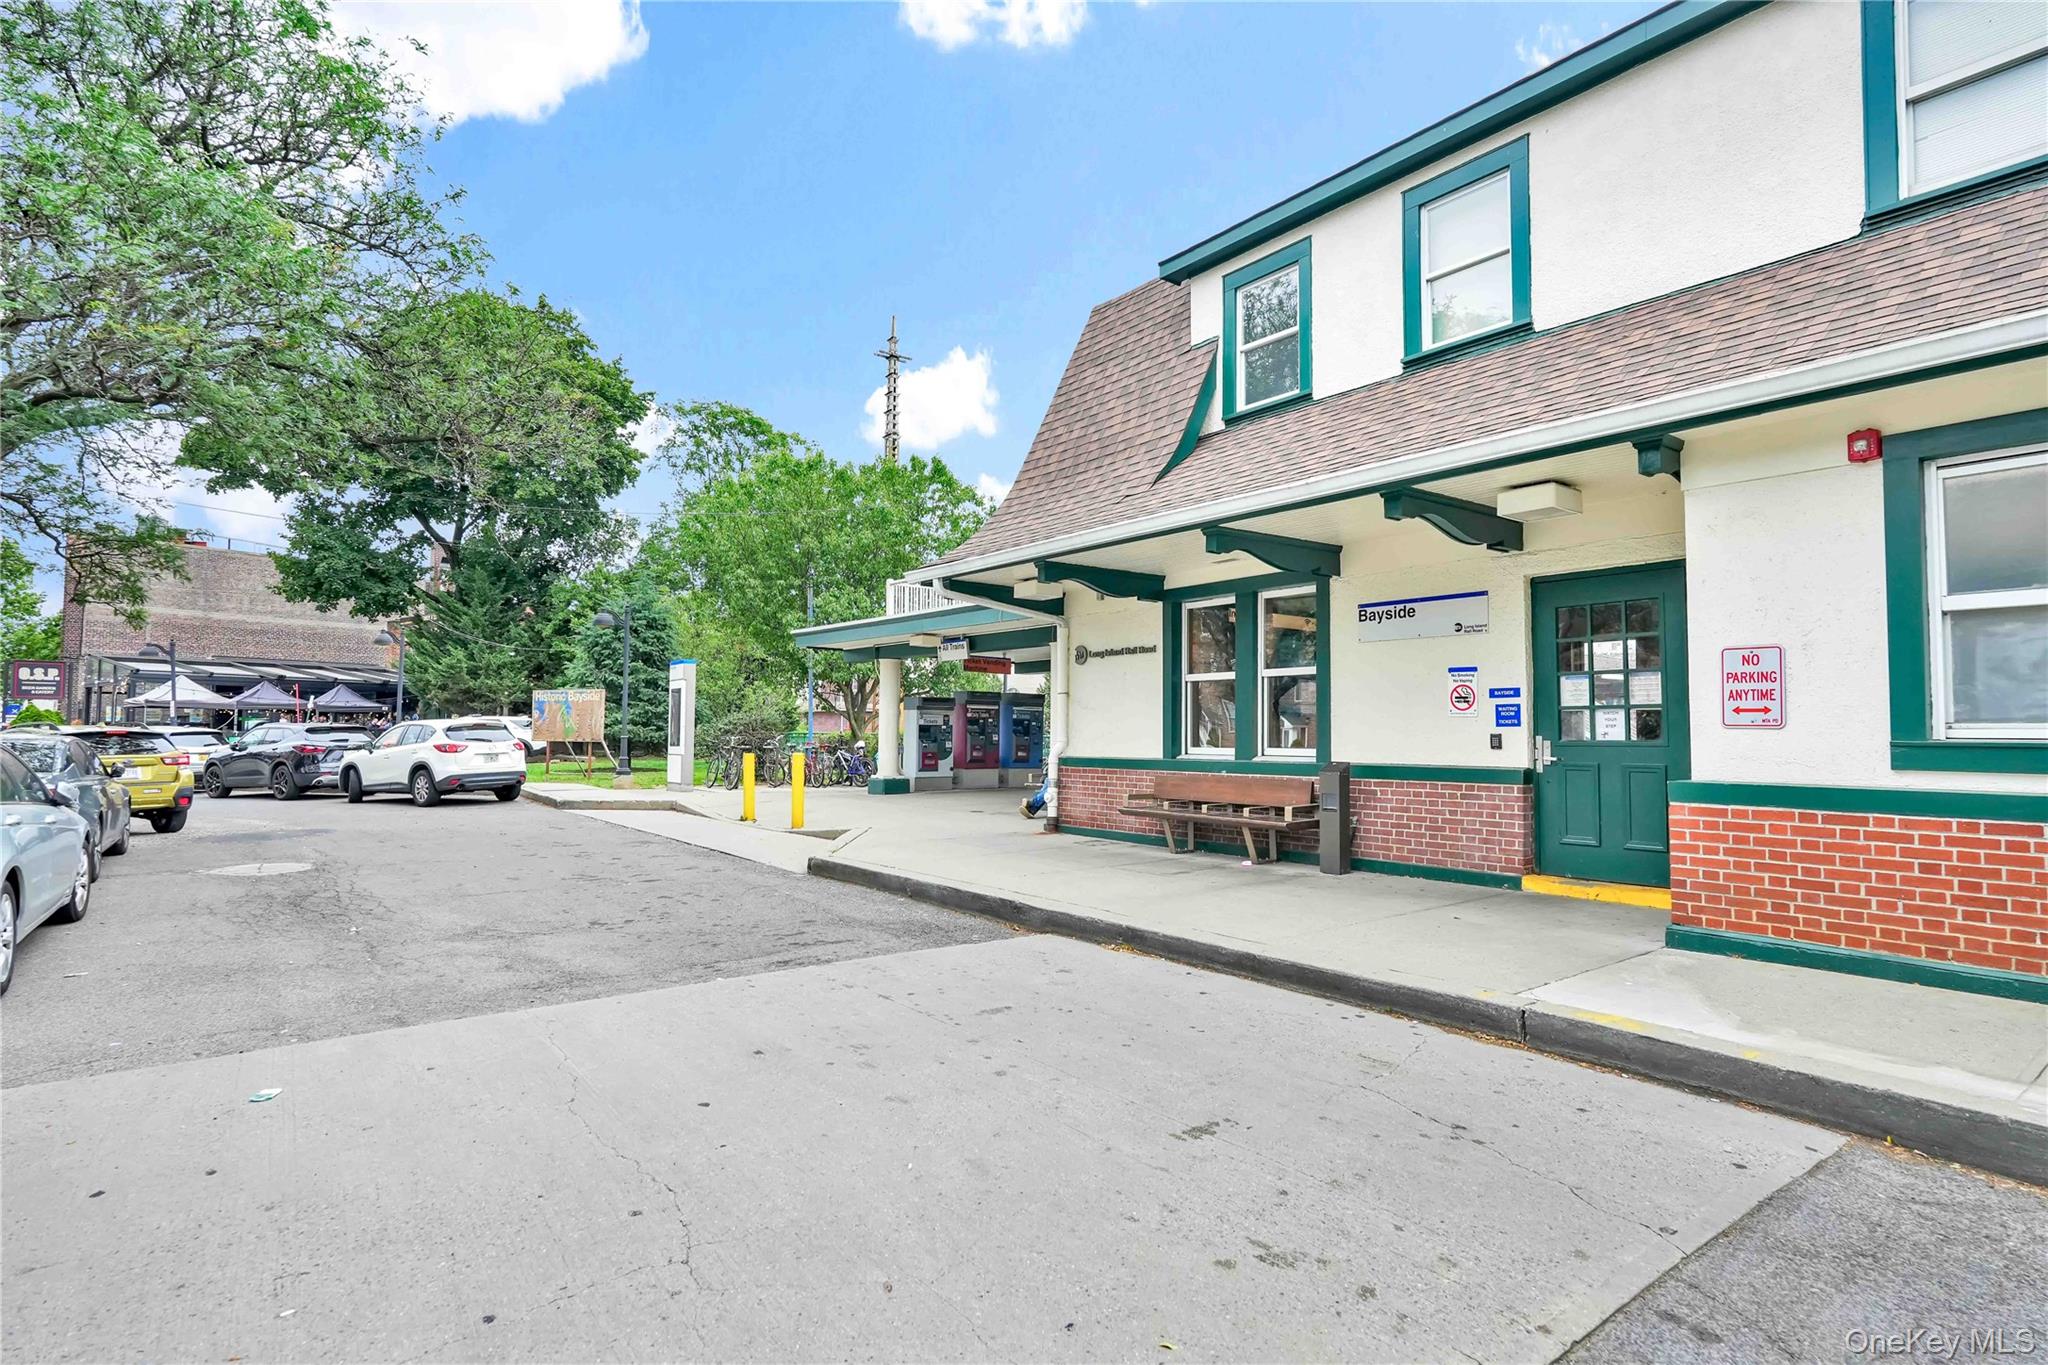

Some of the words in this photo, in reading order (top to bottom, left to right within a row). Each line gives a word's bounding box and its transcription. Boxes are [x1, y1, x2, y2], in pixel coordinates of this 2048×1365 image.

[1358, 605, 1416, 624] Bayside
[1089, 650, 1105, 659] Long
[1105, 648, 1124, 656] Island
[1125, 646, 1138, 655] Rail
[1138, 645, 1157, 653] Road
[1741, 654, 1760, 666] NO
[1726, 671, 1777, 683] PARKING
[535, 691, 566, 701] Historic
[568, 690, 601, 702] Bayside
[1728, 688, 1777, 702] ANYTIME
